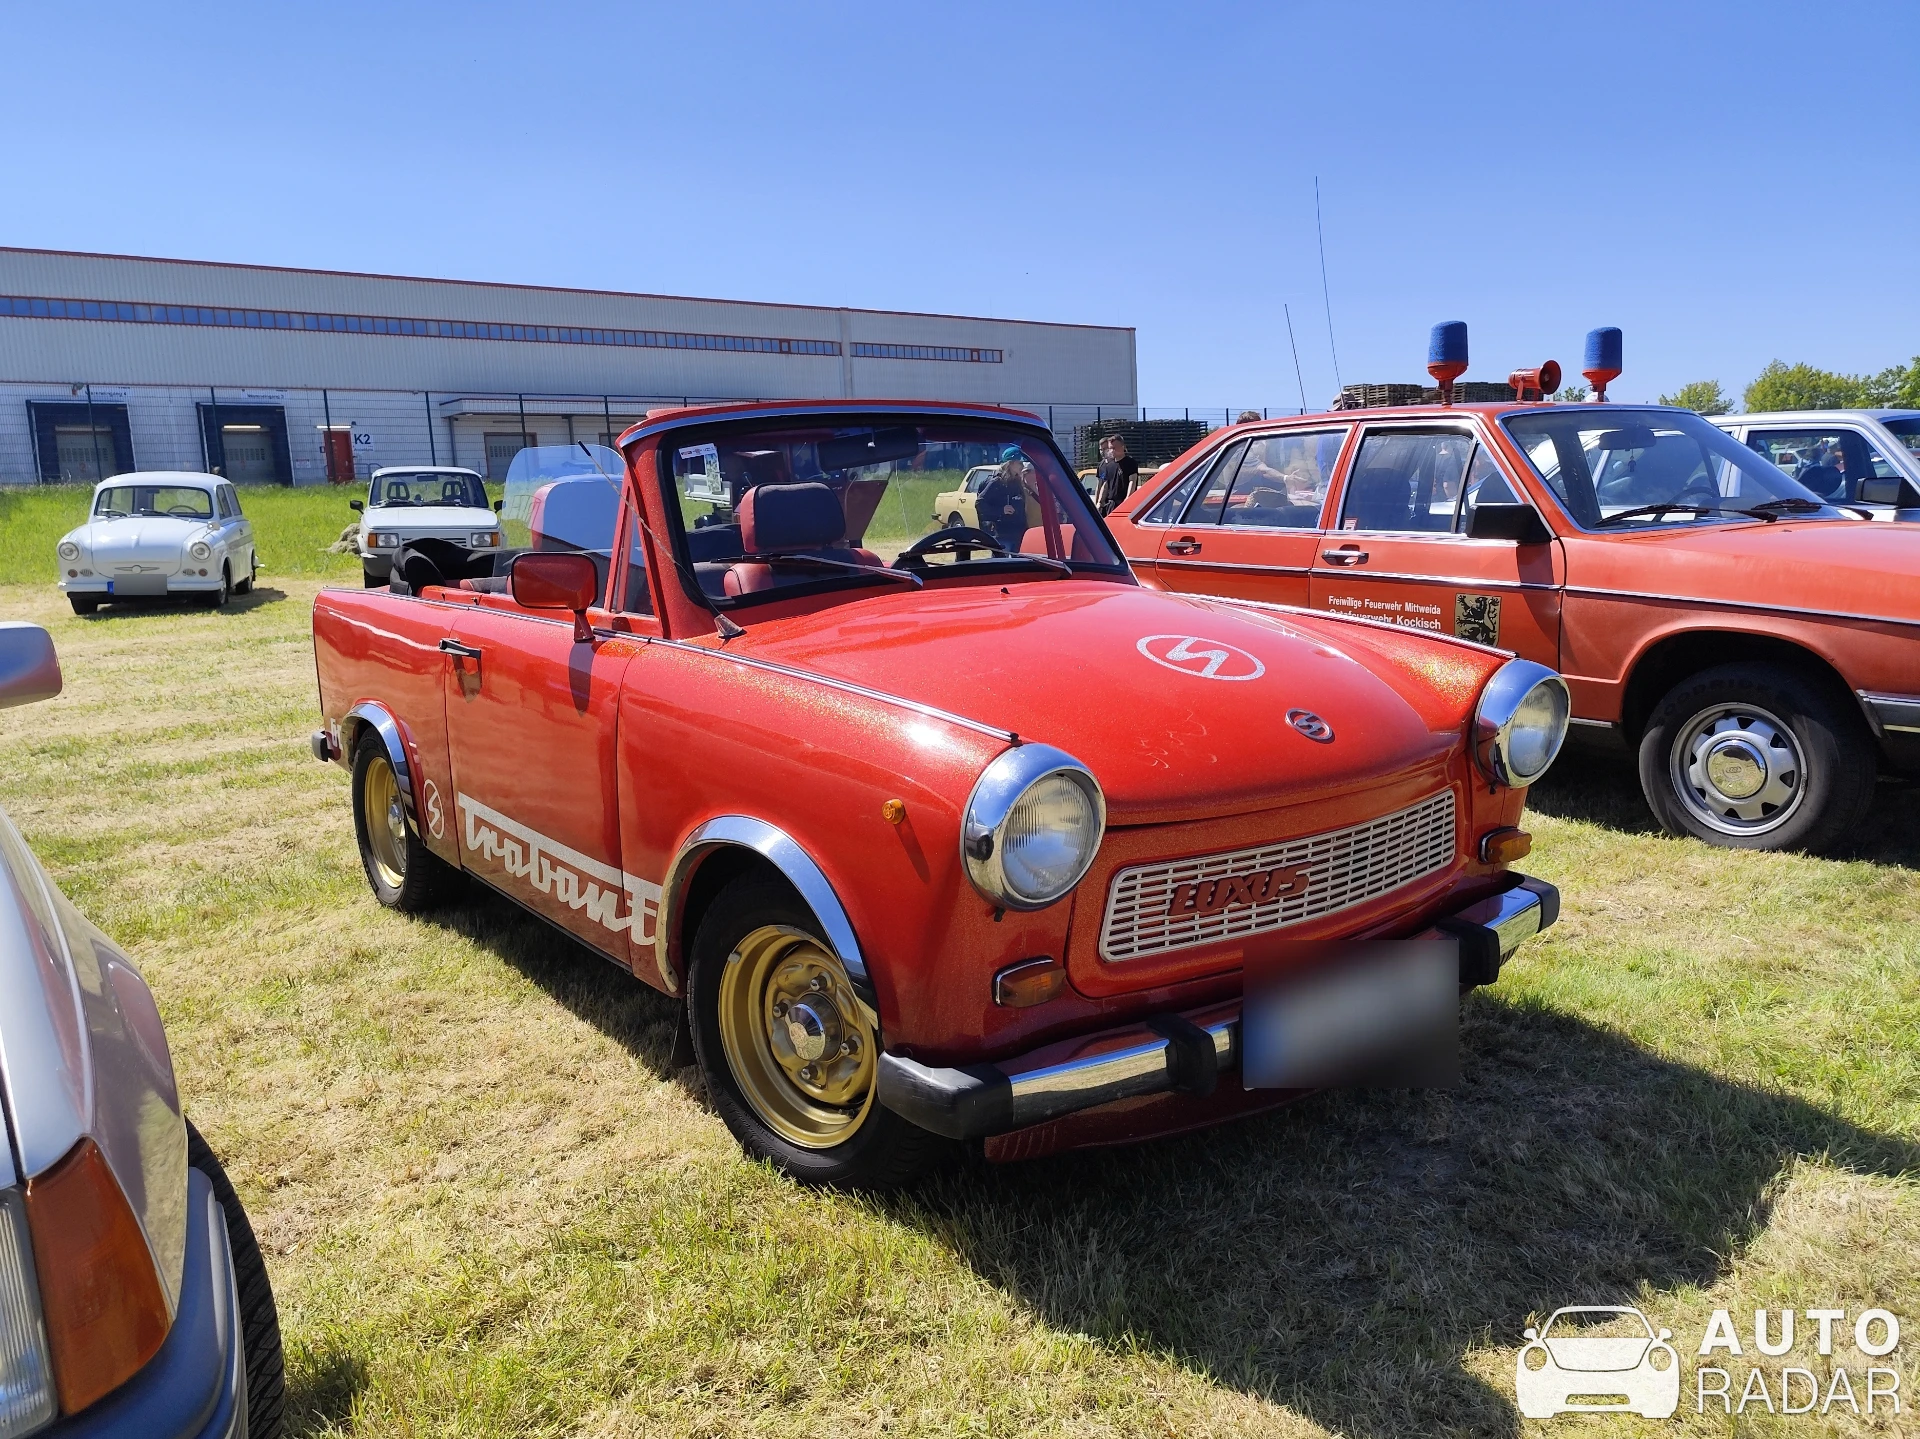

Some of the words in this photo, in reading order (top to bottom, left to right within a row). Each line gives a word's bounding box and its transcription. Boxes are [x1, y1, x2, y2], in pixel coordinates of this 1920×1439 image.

[353, 433, 371, 445] K2
[1328, 595, 1362, 609] Freiwillige
[1364, 598, 1402, 611] Feuerwehr
[1404, 602, 1441, 615] Mittweida
[1396, 614, 1441, 630] Kockisch
[458, 791, 663, 946] Trabant
[1167, 861, 1313, 916] LUXUS
